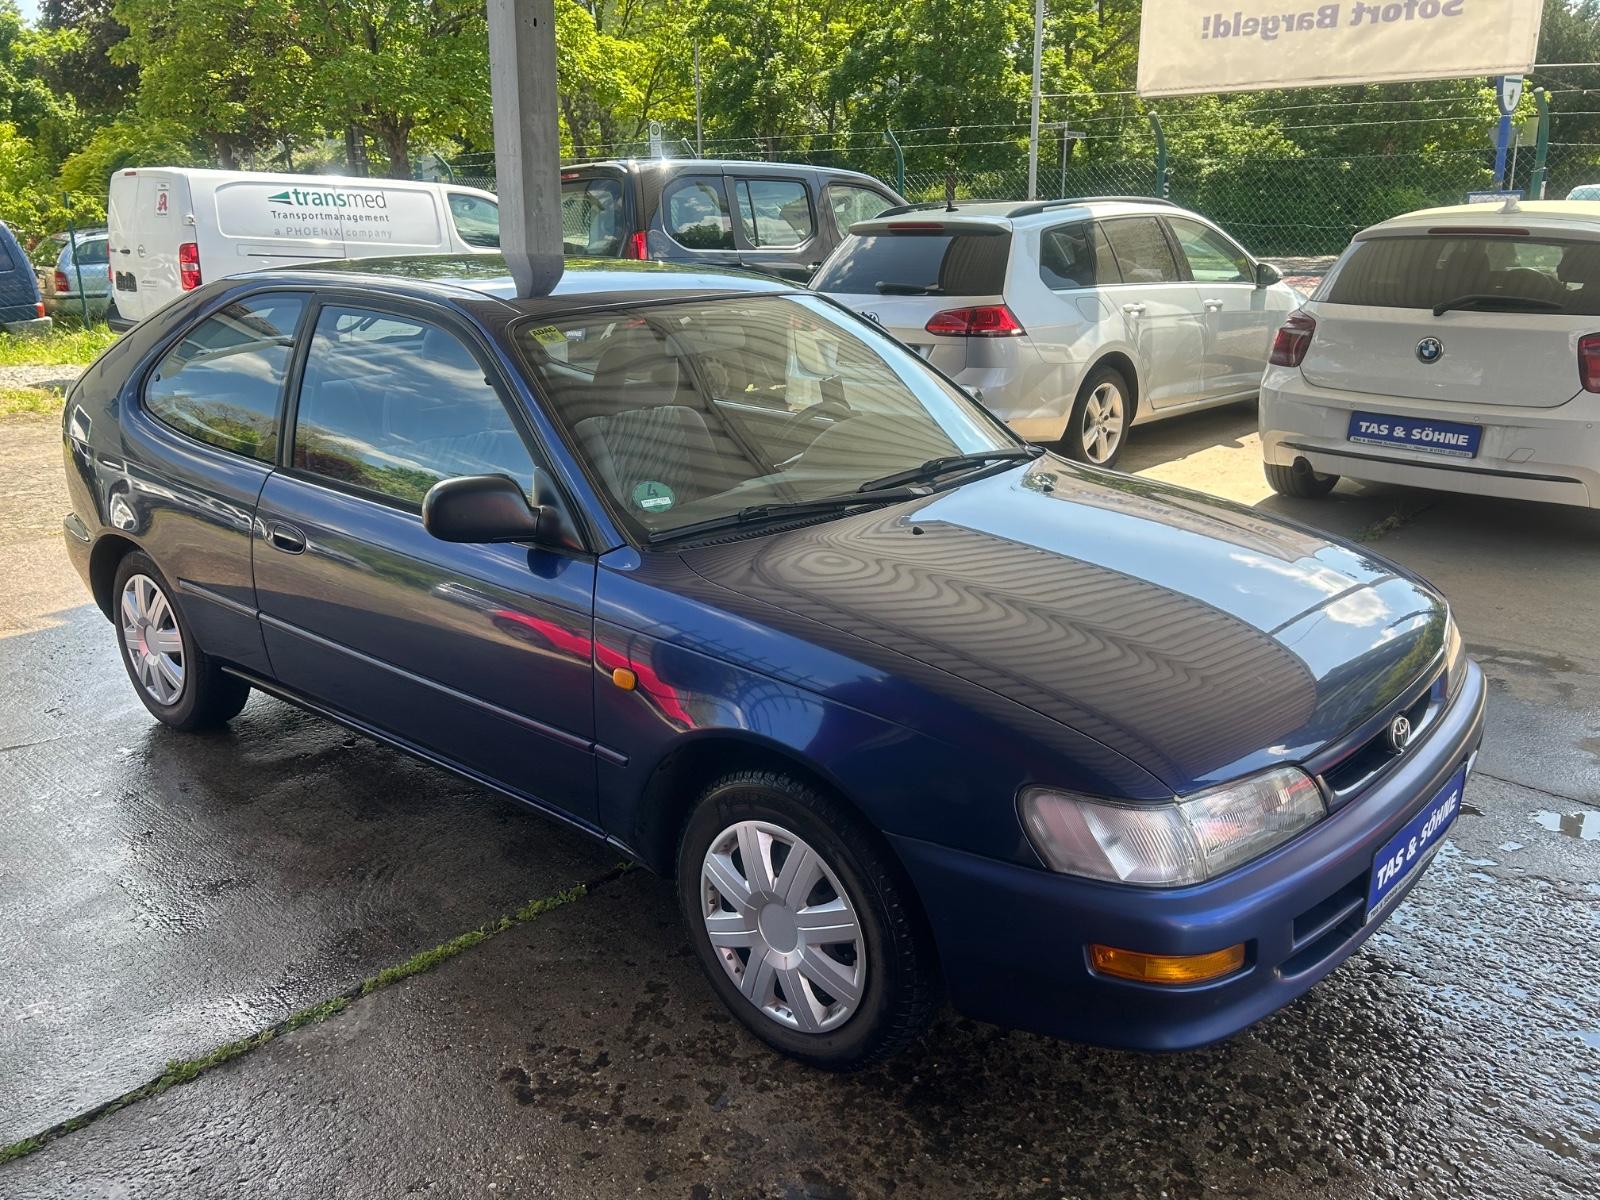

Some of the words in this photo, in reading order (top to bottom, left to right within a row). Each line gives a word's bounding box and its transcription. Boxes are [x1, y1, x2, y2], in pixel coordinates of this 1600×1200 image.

[292, 188, 387, 209] transmed
[271, 210, 390, 223] Transportmanagement
[274, 228, 281, 236] a
[286, 226, 341, 236] PHOENIX
[345, 229, 392, 239] company
[1359, 421, 1389, 436] TAS
[1393, 426, 1406, 438] &
[1411, 427, 1469, 446] SÖHNE
[1377, 847, 1405, 890] TAS
[1406, 836, 1417, 861] &
[1419, 788, 1458, 847] SÖHNE
